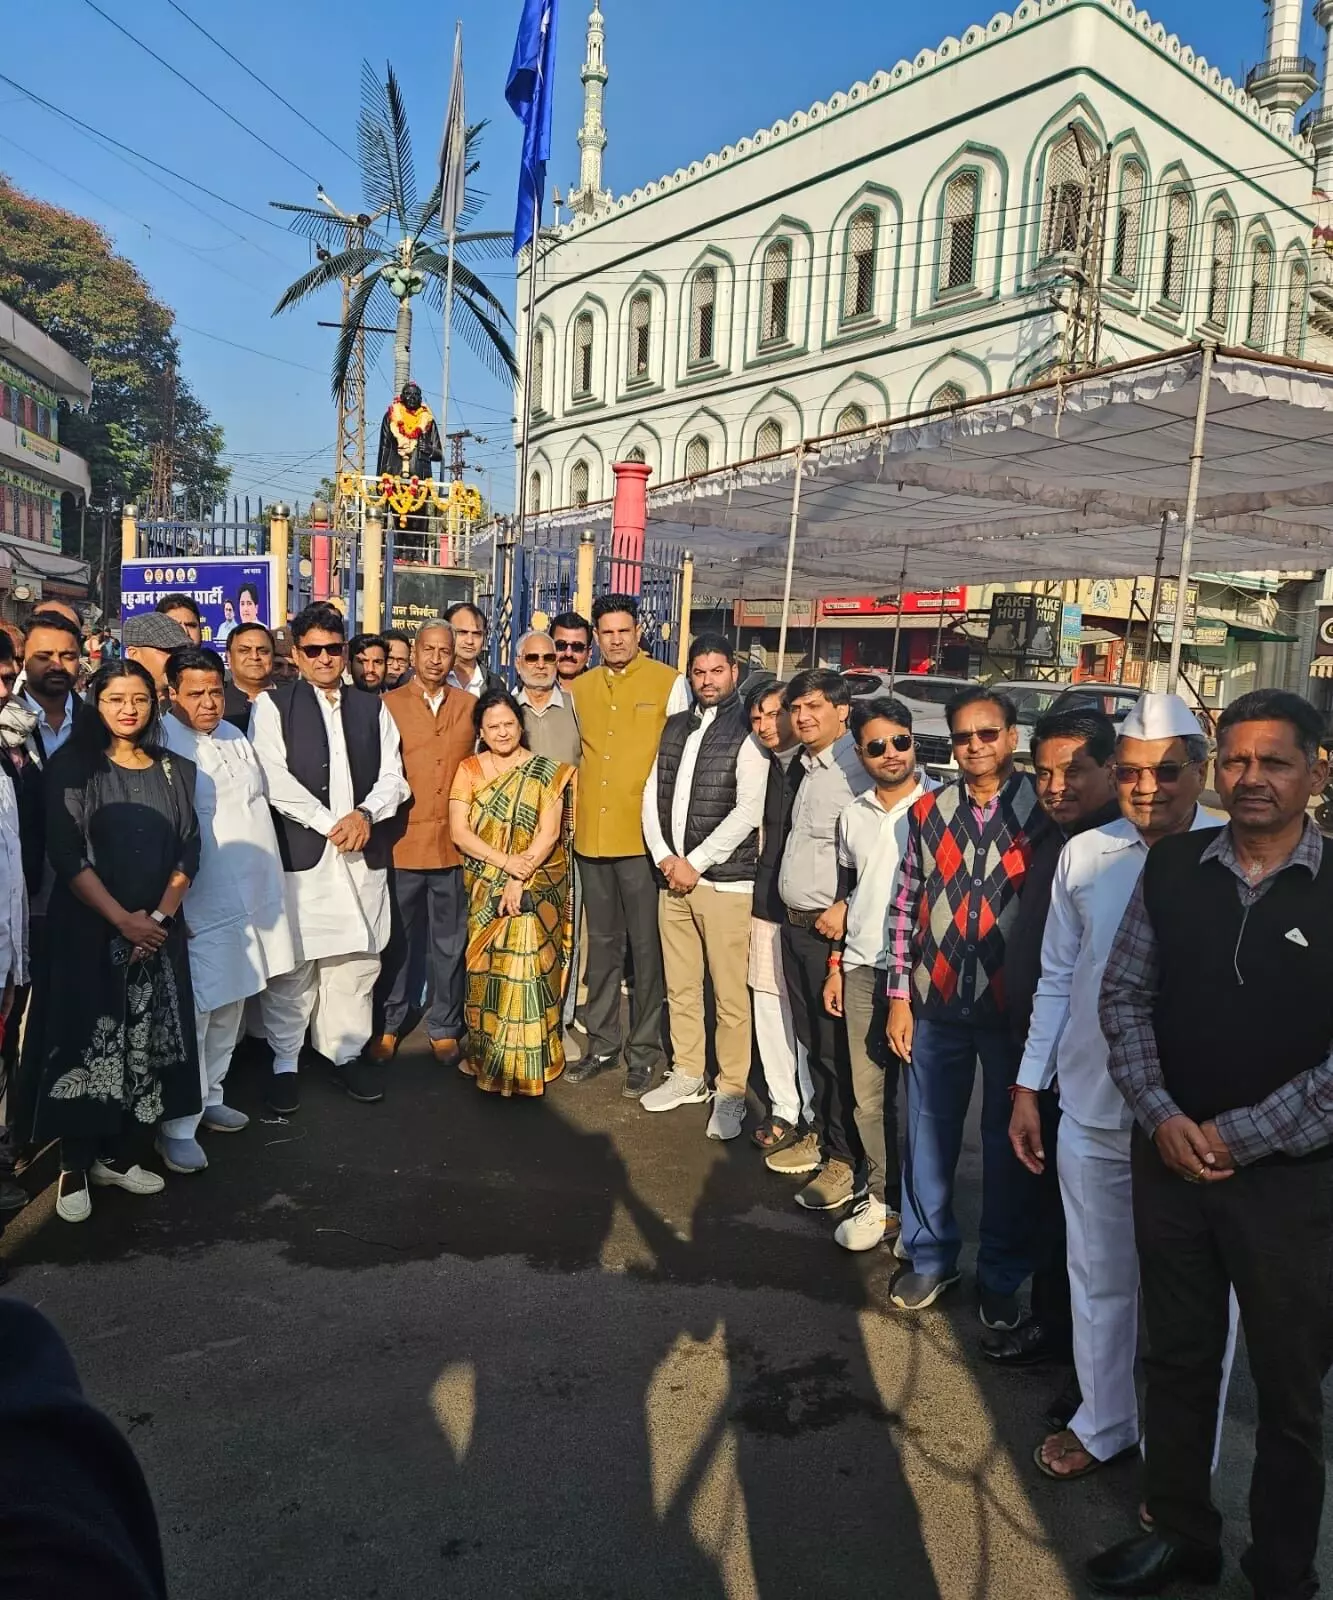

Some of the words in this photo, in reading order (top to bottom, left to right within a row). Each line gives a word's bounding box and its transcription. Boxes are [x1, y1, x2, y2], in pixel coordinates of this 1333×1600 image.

[193, 586, 223, 605] पार्टी
[995, 596, 1031, 608] CAKE
[1035, 597, 1060, 611] CAKE
[997, 608, 1025, 619] HUB
[1036, 609, 1056, 623] HUB
